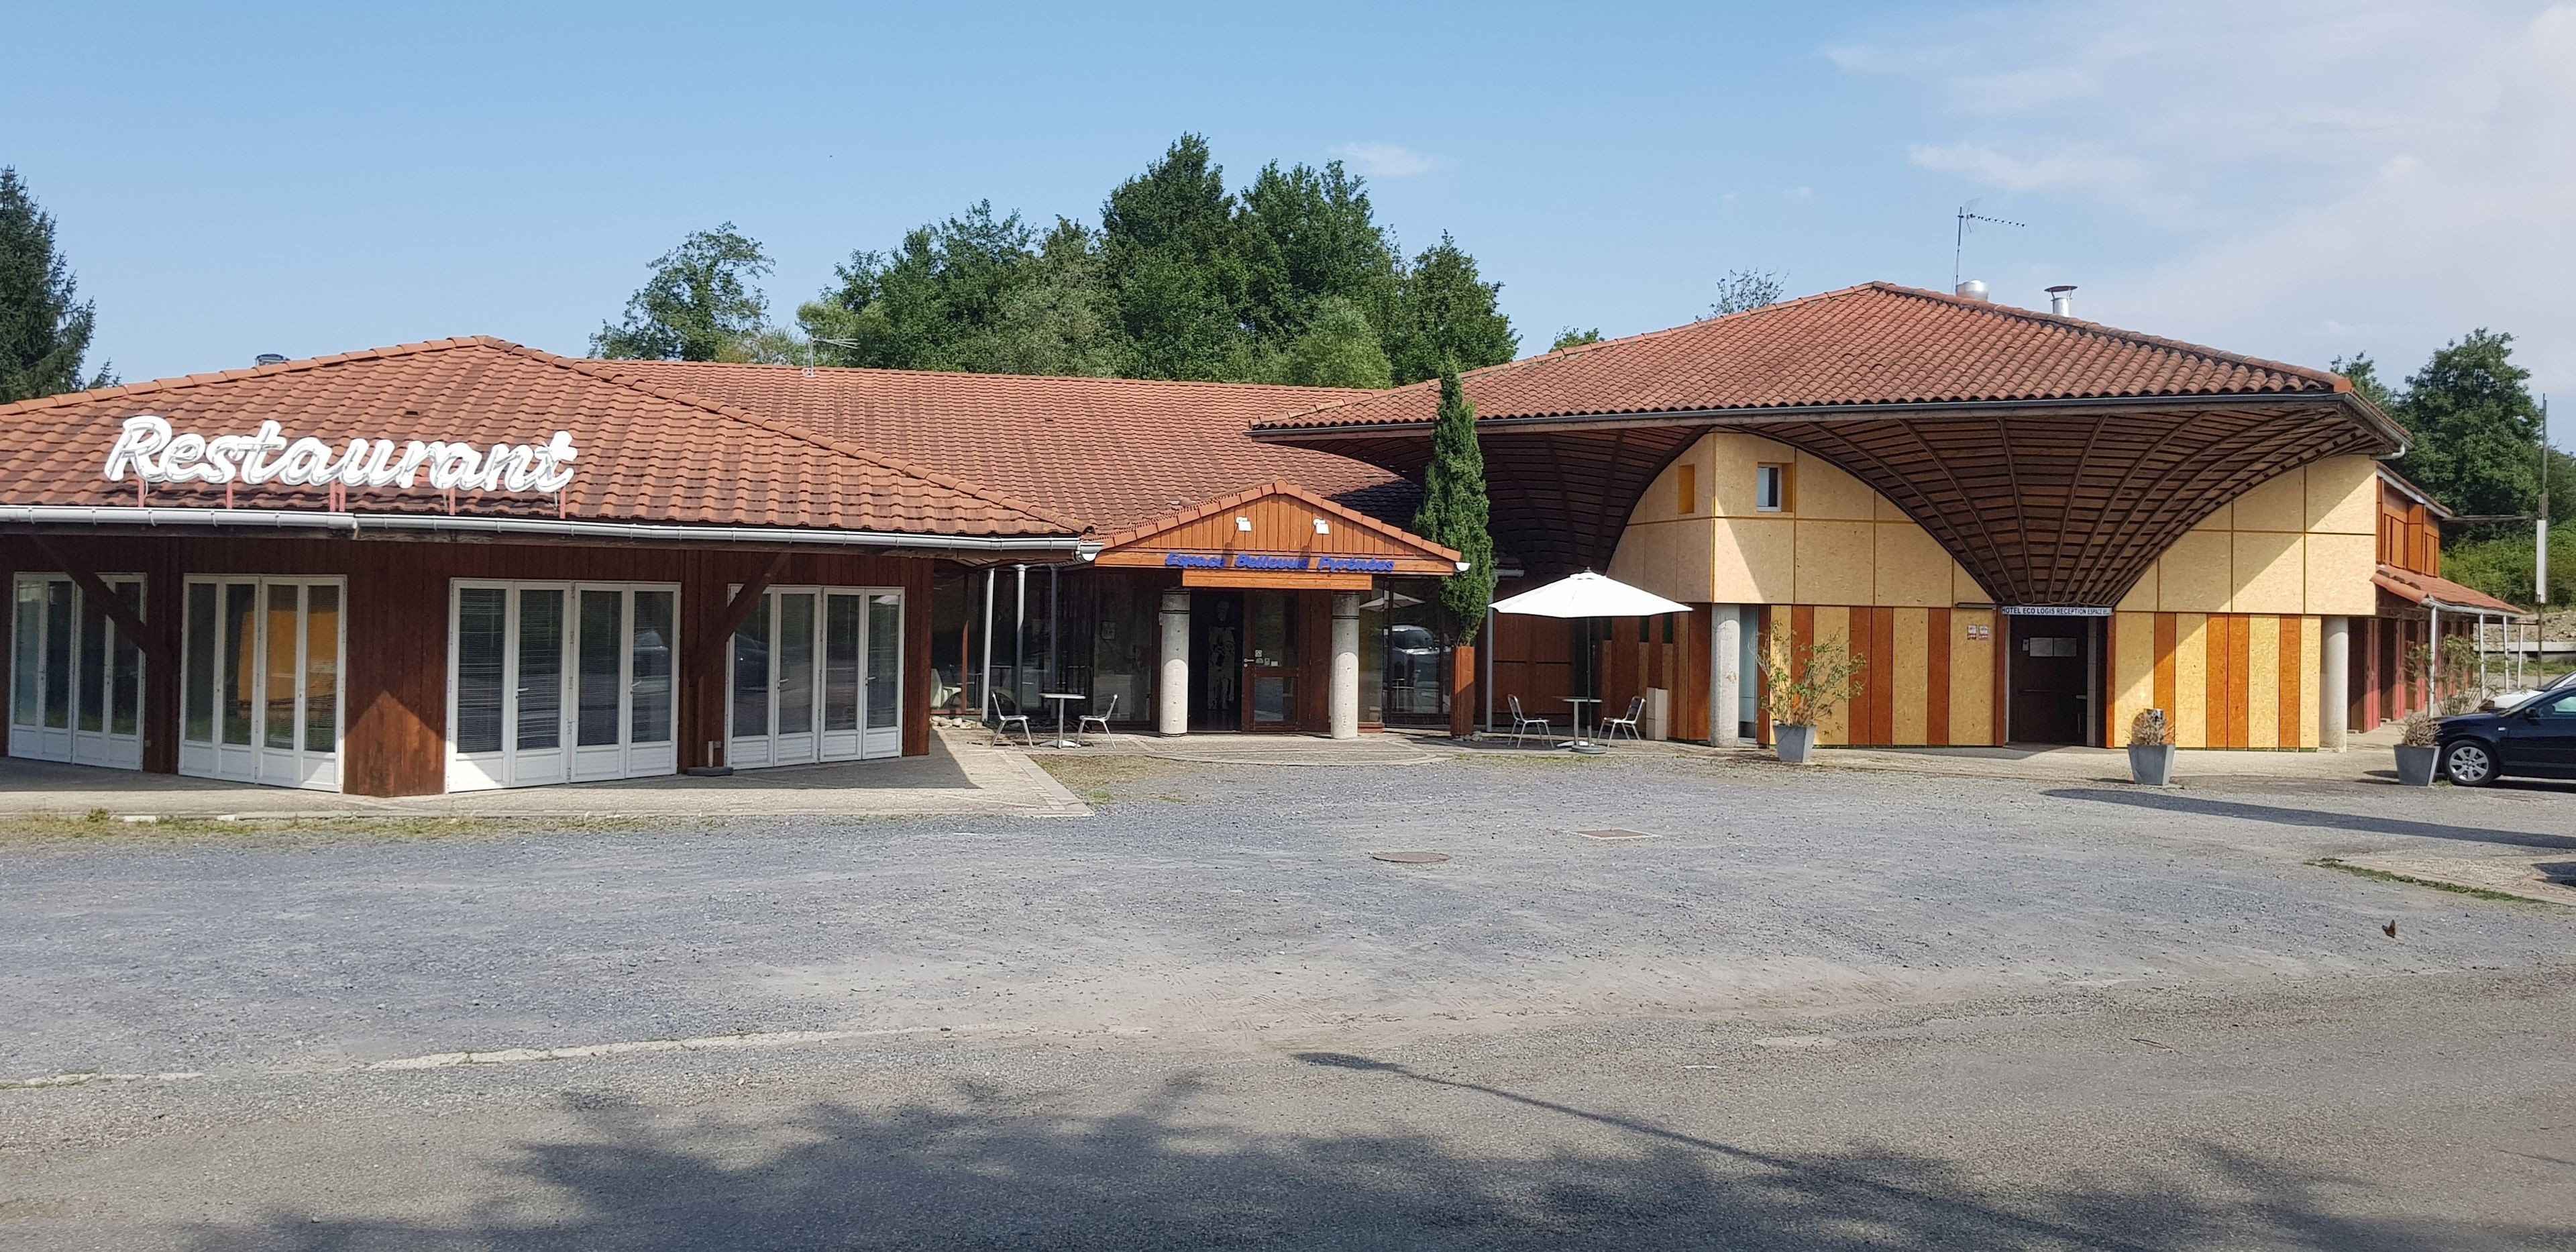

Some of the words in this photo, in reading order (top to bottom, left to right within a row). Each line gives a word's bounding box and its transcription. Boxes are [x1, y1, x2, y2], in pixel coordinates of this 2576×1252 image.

[104, 415, 578, 493] Restaurant
[1166, 552, 1225, 568] Espace
[1235, 554, 1309, 569] Bellevue
[1318, 556, 1394, 572] Pyrénées
